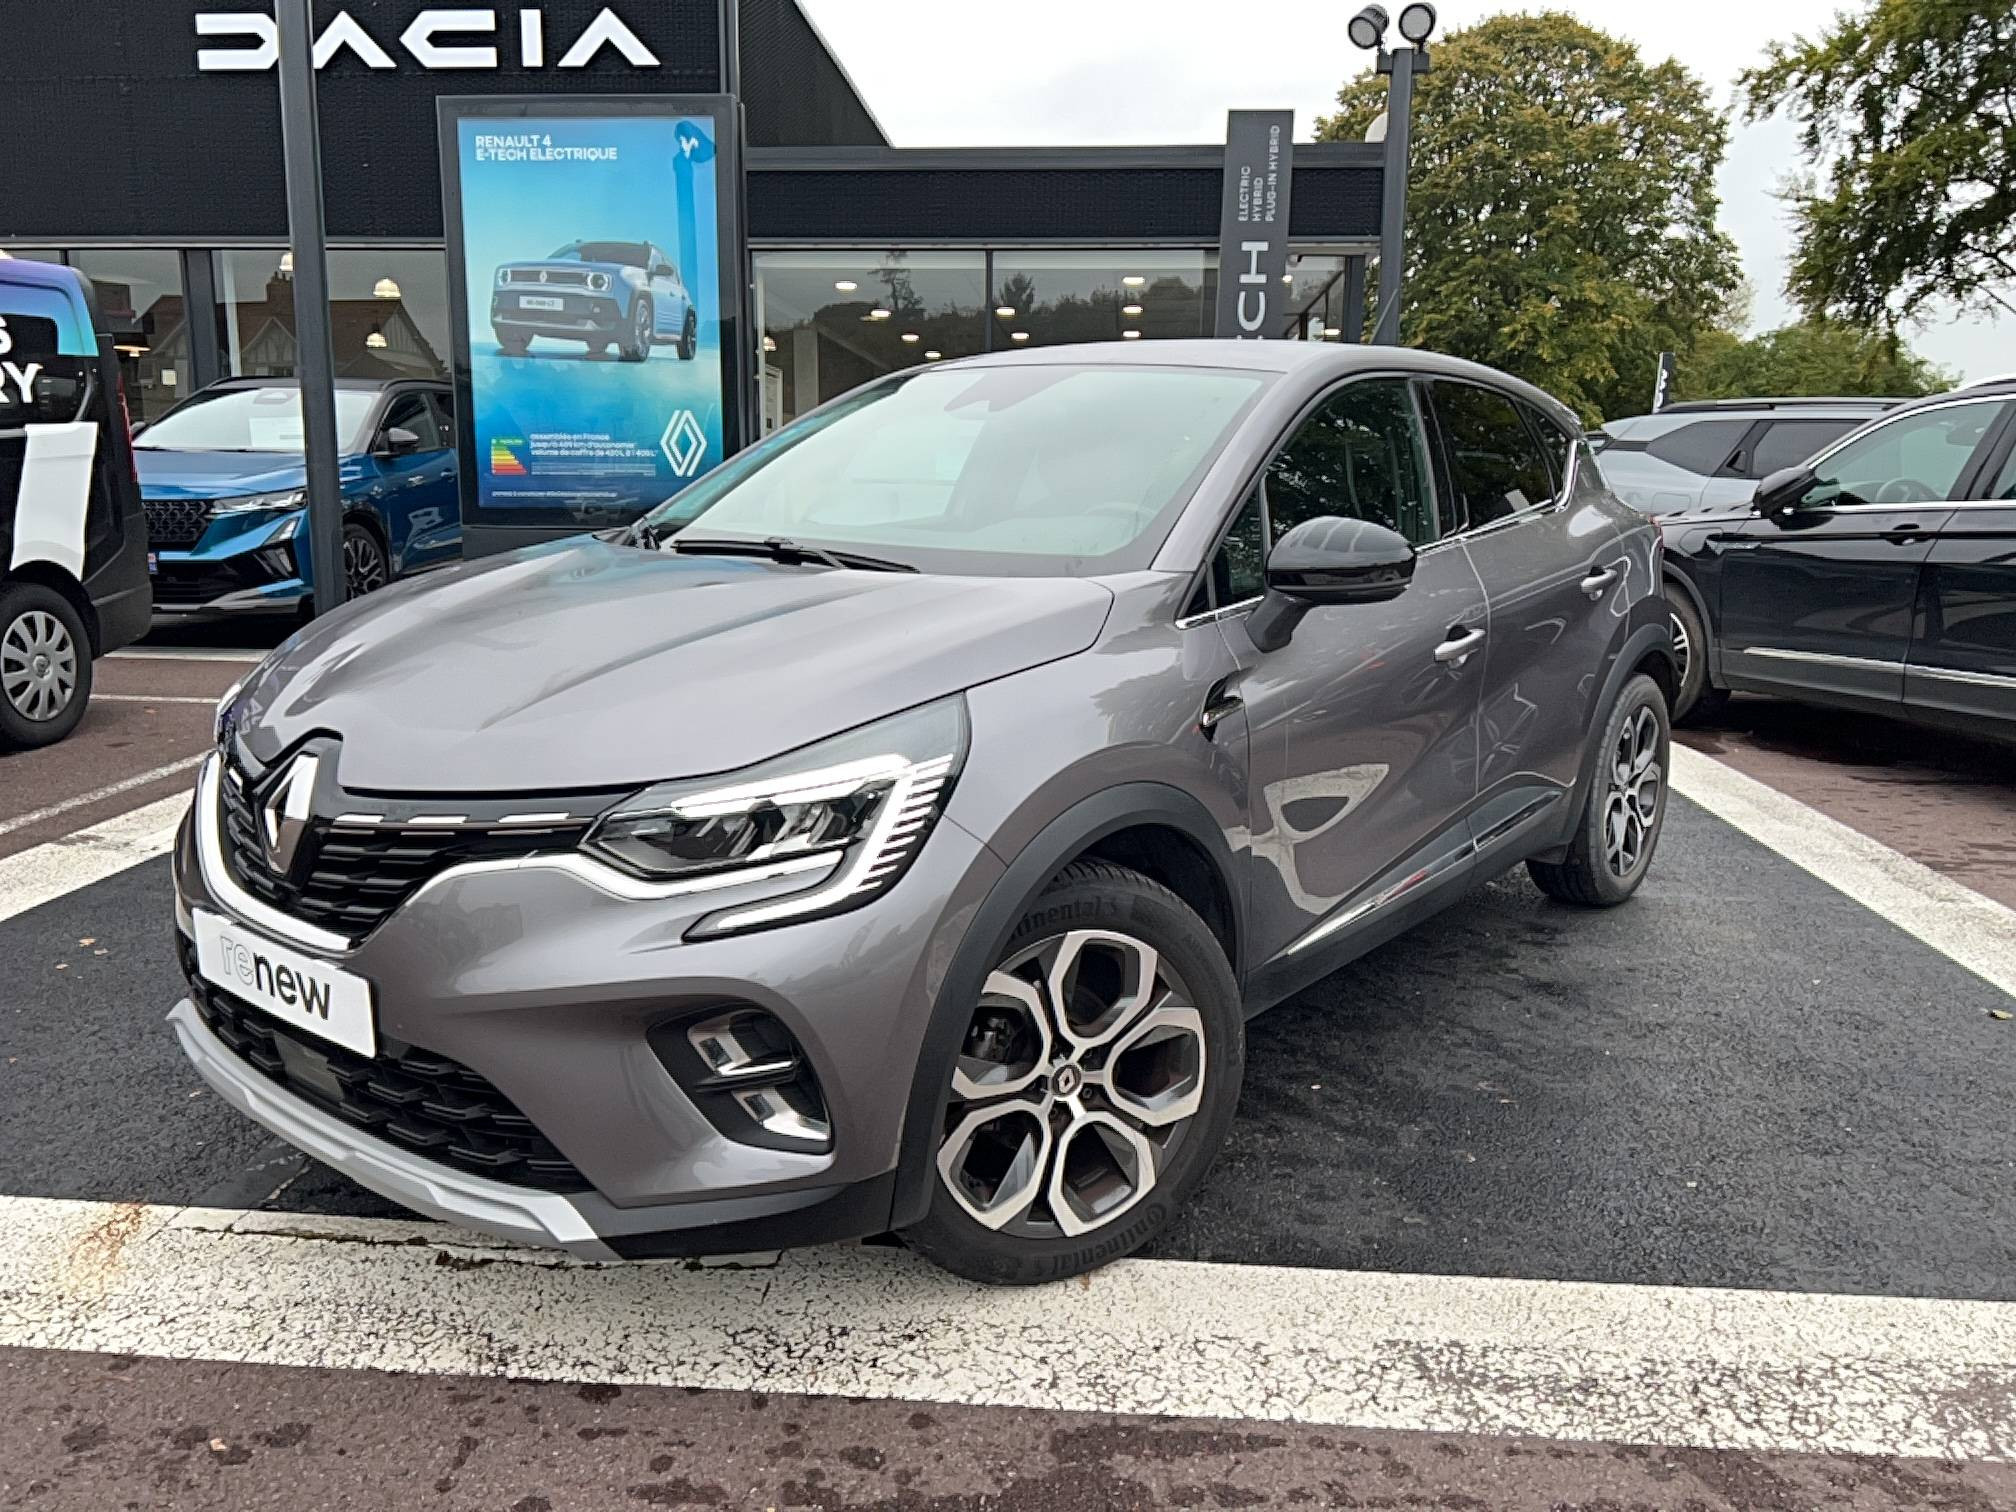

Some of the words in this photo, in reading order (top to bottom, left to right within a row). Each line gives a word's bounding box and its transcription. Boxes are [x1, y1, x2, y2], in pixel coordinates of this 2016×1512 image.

[195, 6, 662, 71] DACIA
[475, 134, 540, 148] RENAULT
[542, 134, 552, 147] 4
[475, 148, 527, 161] E-TECH
[1268, 124, 1280, 171] HYBRID
[1238, 165, 1251, 222] ELECTRIC
[1252, 176, 1264, 222] HYBRID
[1265, 171, 1278, 222] PLUG-IN
[1237, 241, 1270, 341] CH
[219, 935, 331, 1021] renew
